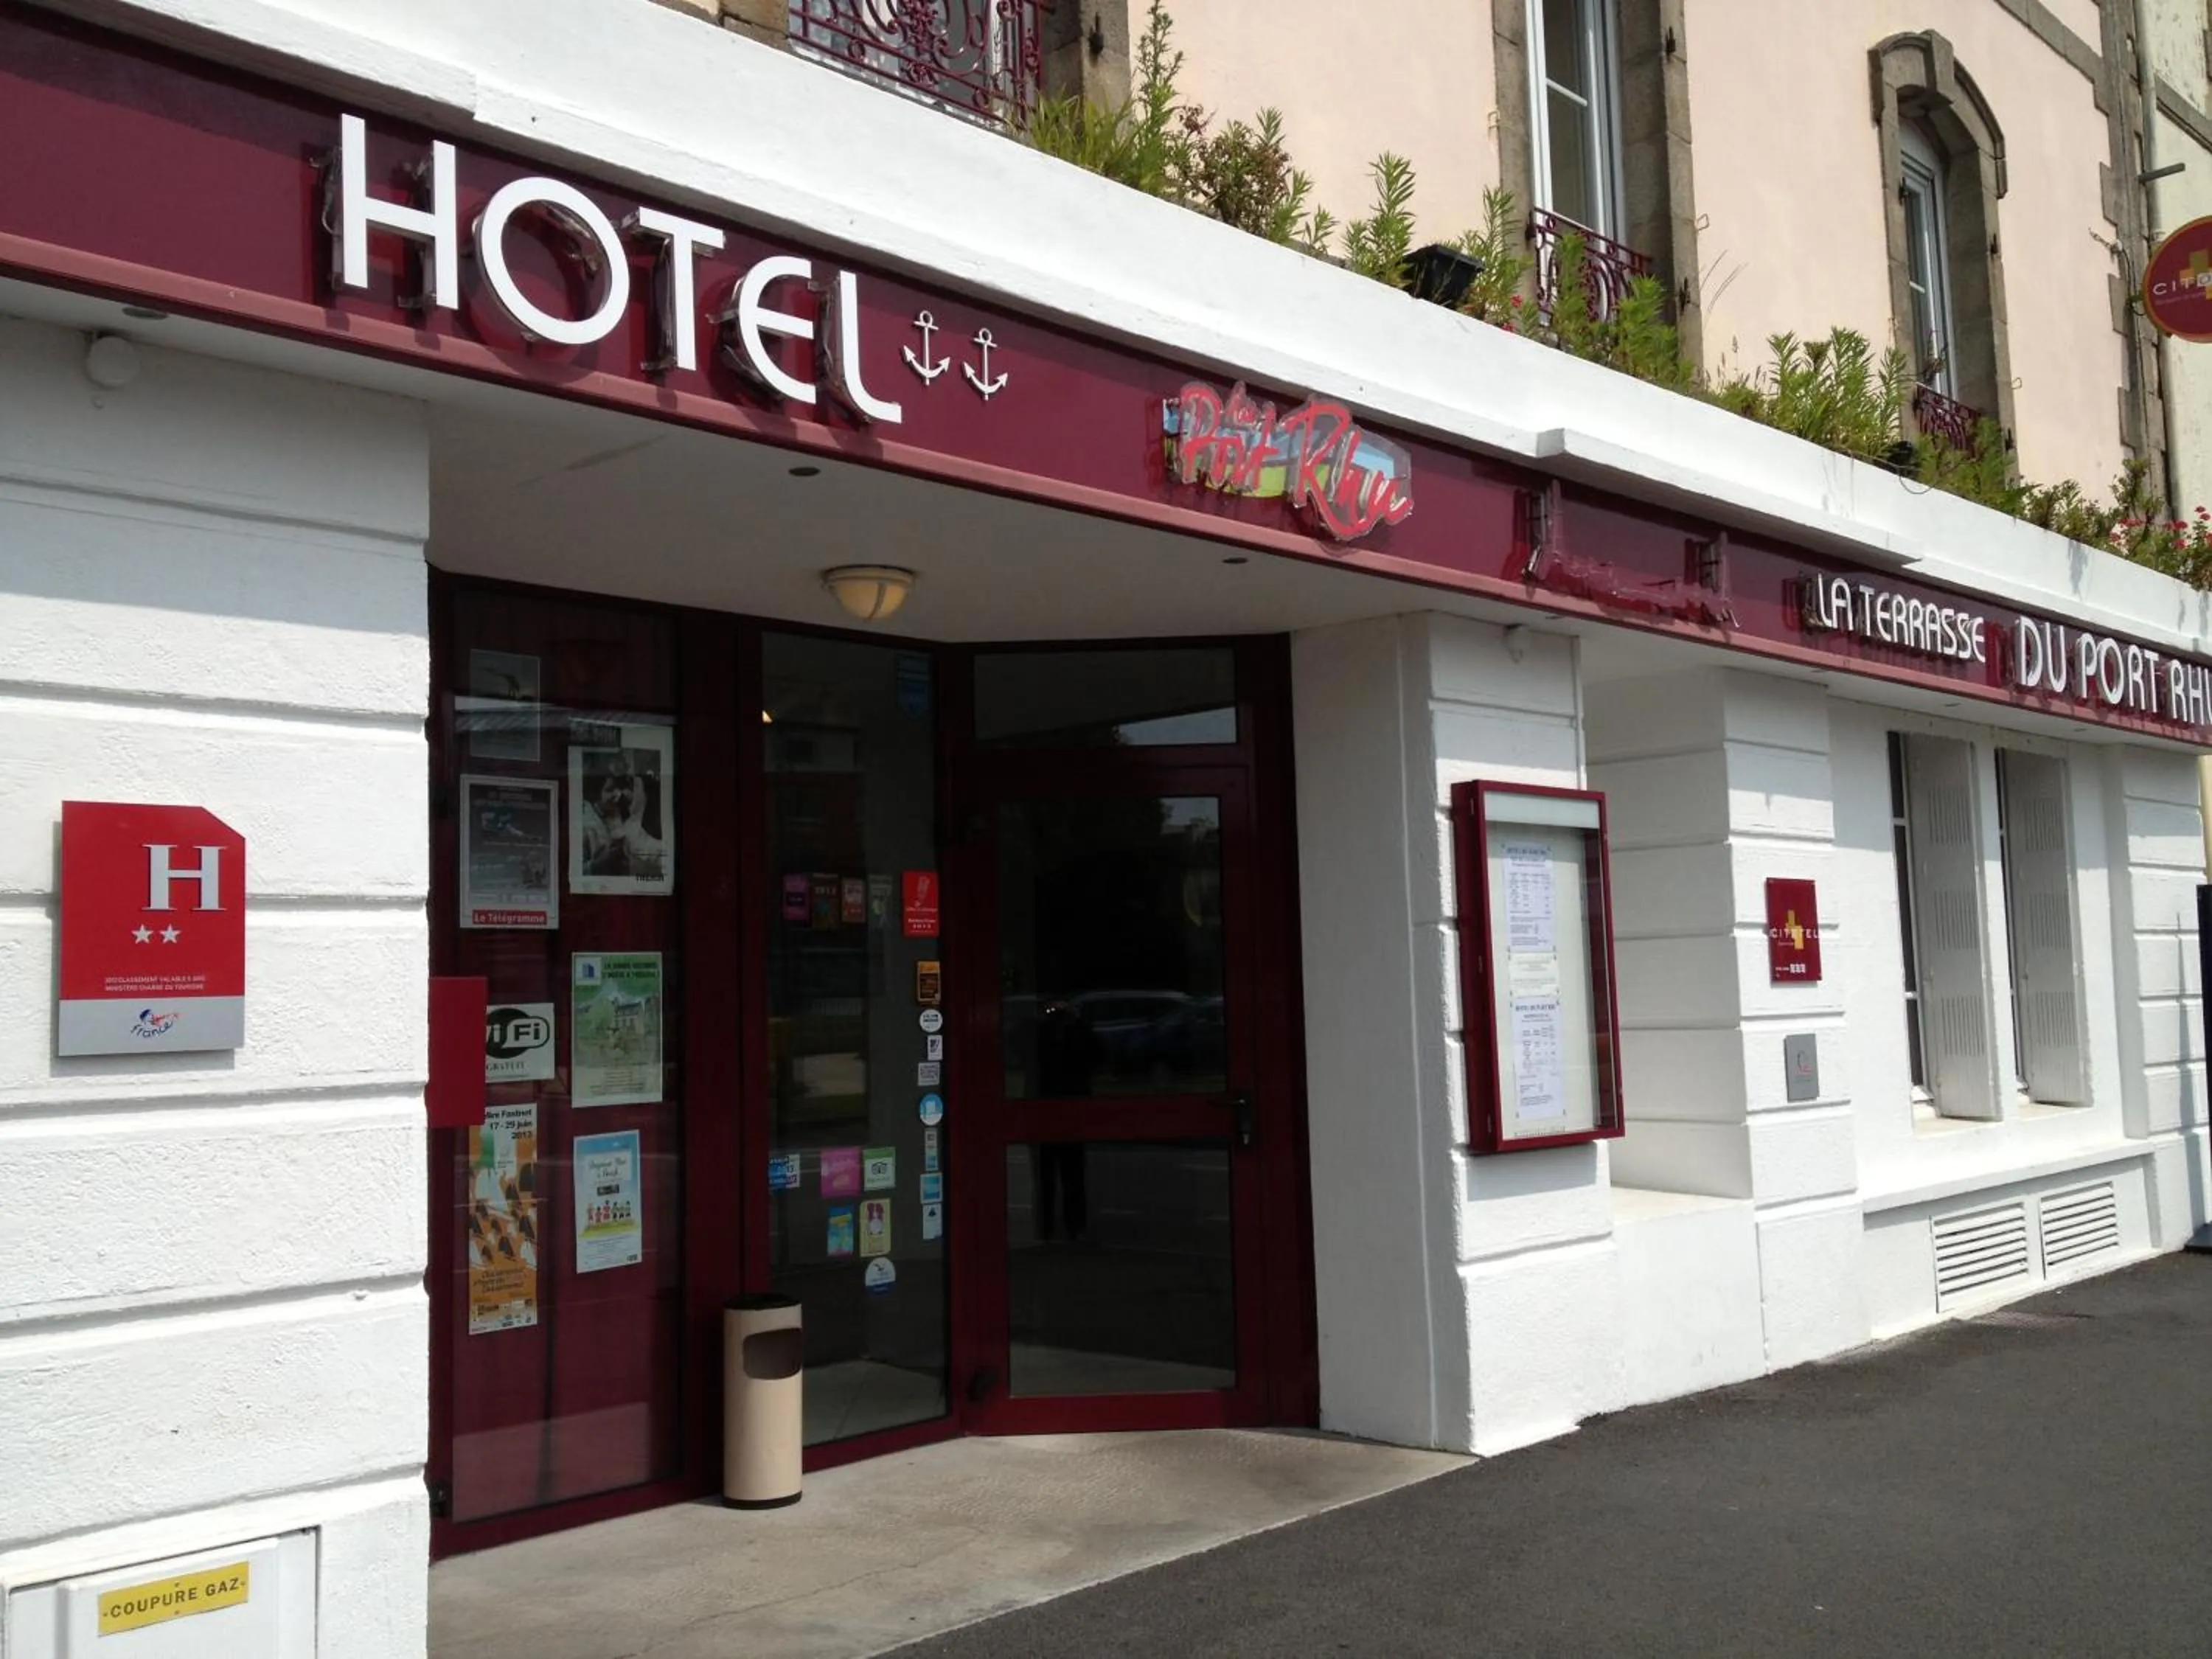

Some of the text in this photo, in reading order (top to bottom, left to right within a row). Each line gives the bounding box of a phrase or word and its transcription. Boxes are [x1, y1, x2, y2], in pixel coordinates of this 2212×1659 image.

[341, 113, 902, 425] HOTEL
[1279, 397, 1414, 542] Rhu
[1817, 572, 1854, 632] LA
[1858, 584, 1986, 664] TERRASSE
[2017, 616, 2067, 693] DU
[2079, 632, 2161, 714] PORT
[141, 844, 228, 911] H
[474, 911, 546, 925] Le Télégramme
[110, 1576, 240, 1618] COUPURE GAZ
